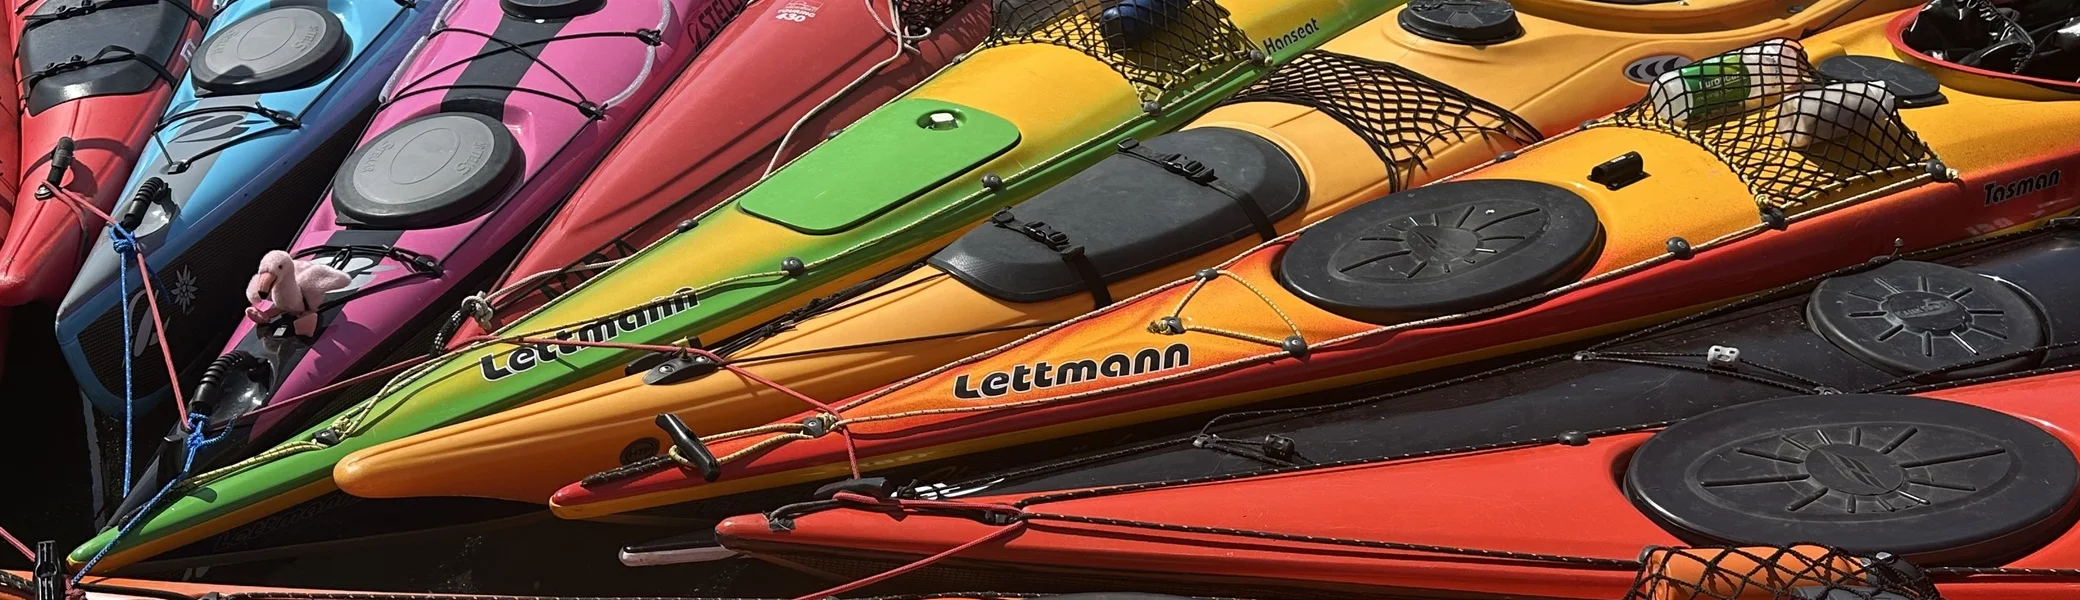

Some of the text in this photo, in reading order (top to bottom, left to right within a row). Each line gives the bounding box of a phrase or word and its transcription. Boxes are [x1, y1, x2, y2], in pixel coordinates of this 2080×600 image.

[776, 12, 806, 22] 430
[1262, 17, 1320, 55] Hanseat
[1983, 169, 2061, 207] Tasman
[479, 286, 700, 382] Lettmann
[952, 343, 1191, 400] Lettmann
